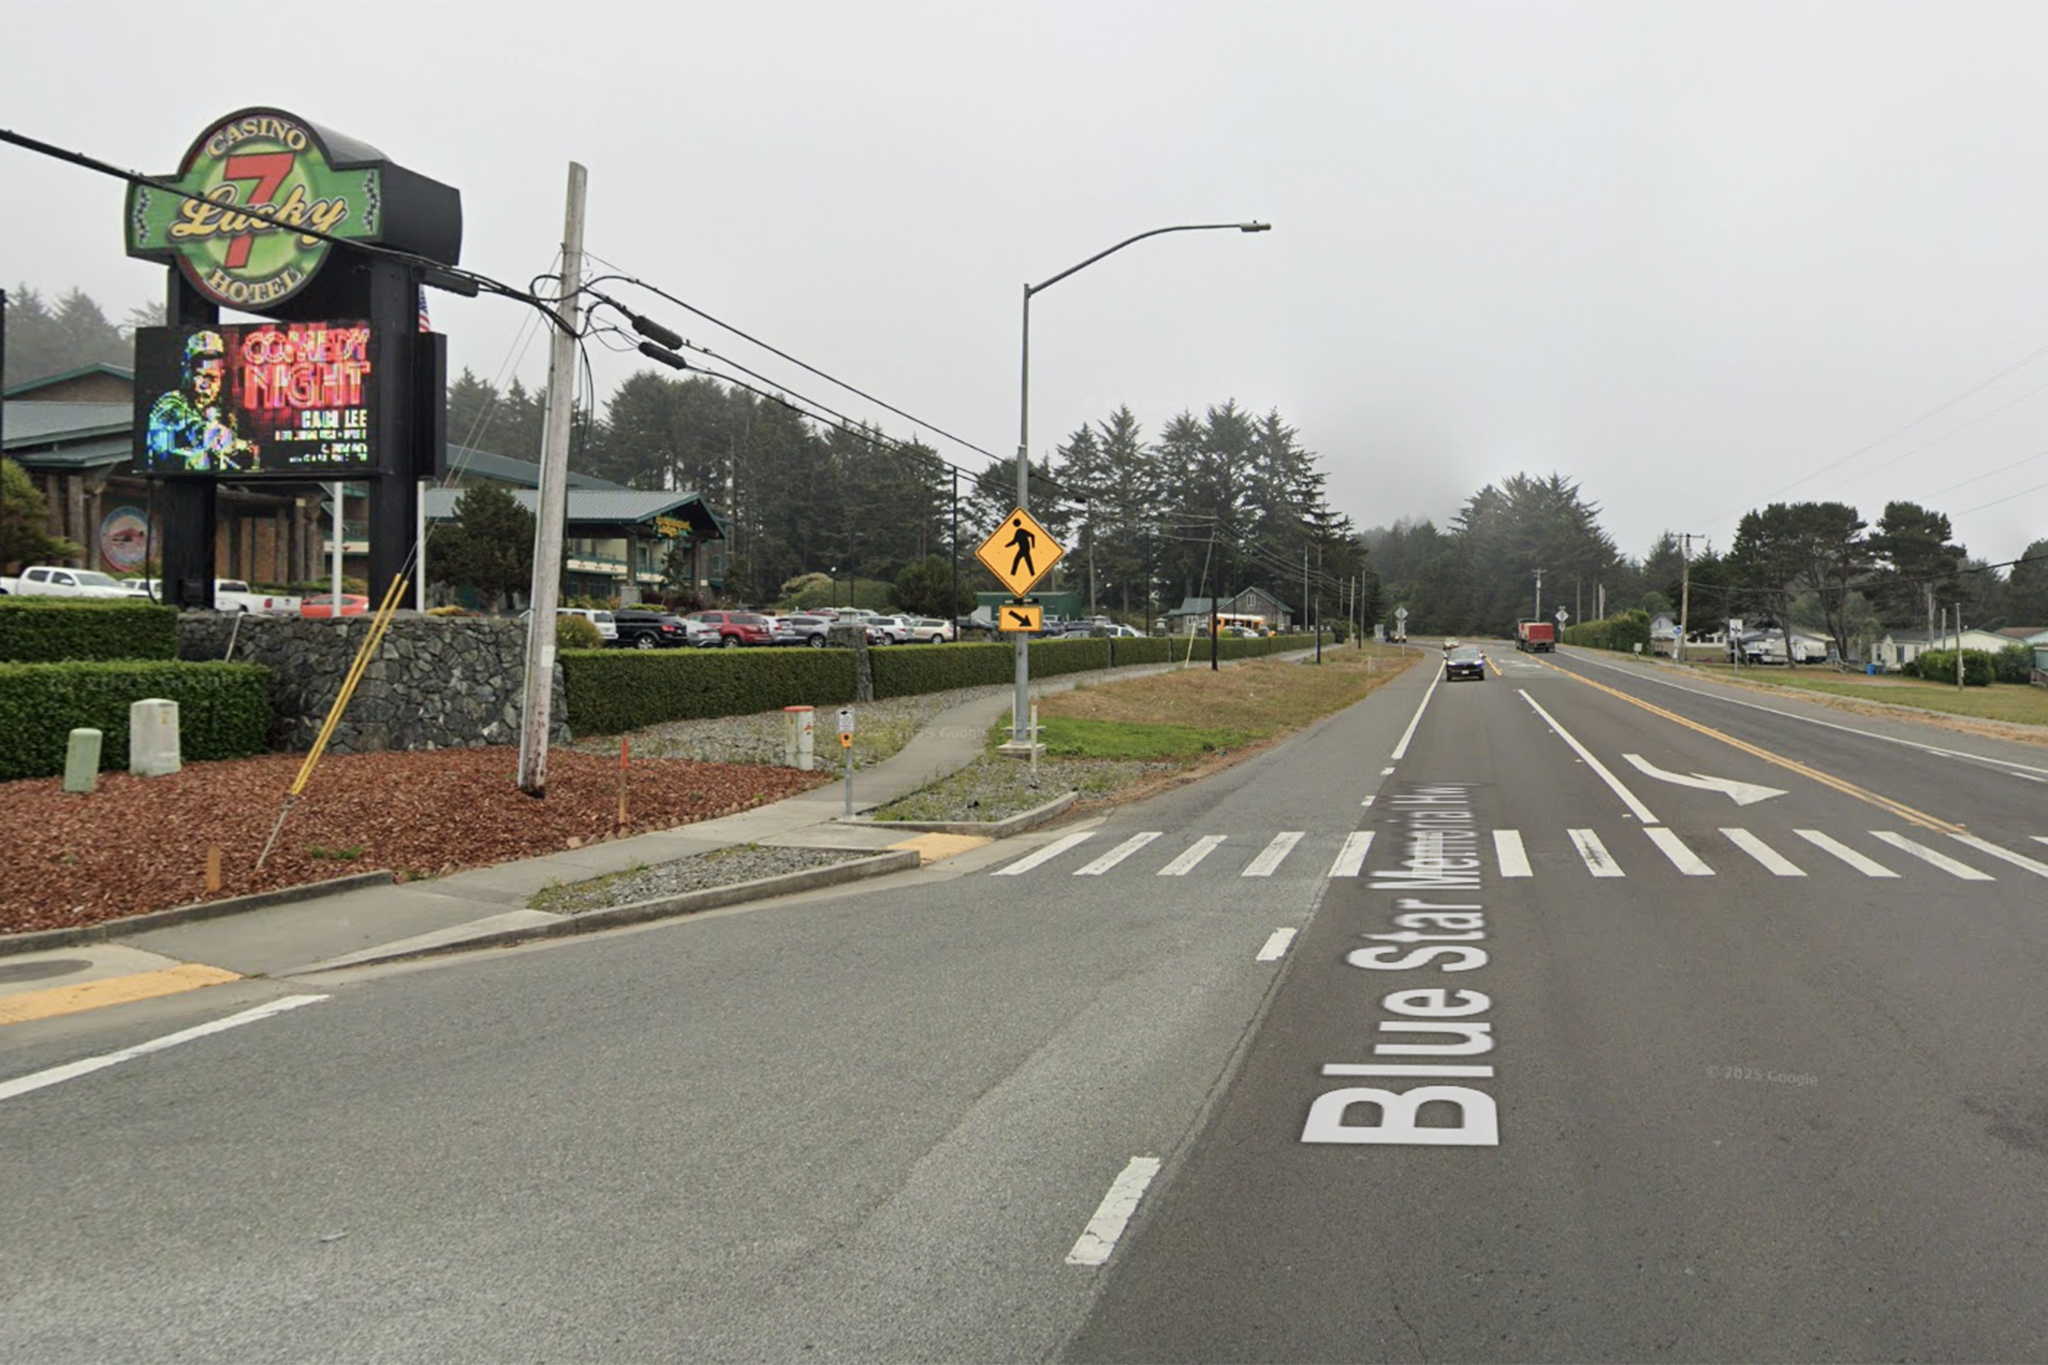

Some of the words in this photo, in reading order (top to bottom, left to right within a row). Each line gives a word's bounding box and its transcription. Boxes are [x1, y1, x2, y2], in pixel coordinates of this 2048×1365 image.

[206, 117, 307, 158] CASINO
[170, 184, 346, 246] Lucky
[223, 151, 296, 269] 7
[207, 267, 305, 301] HOTEL
[244, 362, 370, 410] NIGHT
[345, 409, 367, 428] LEE
